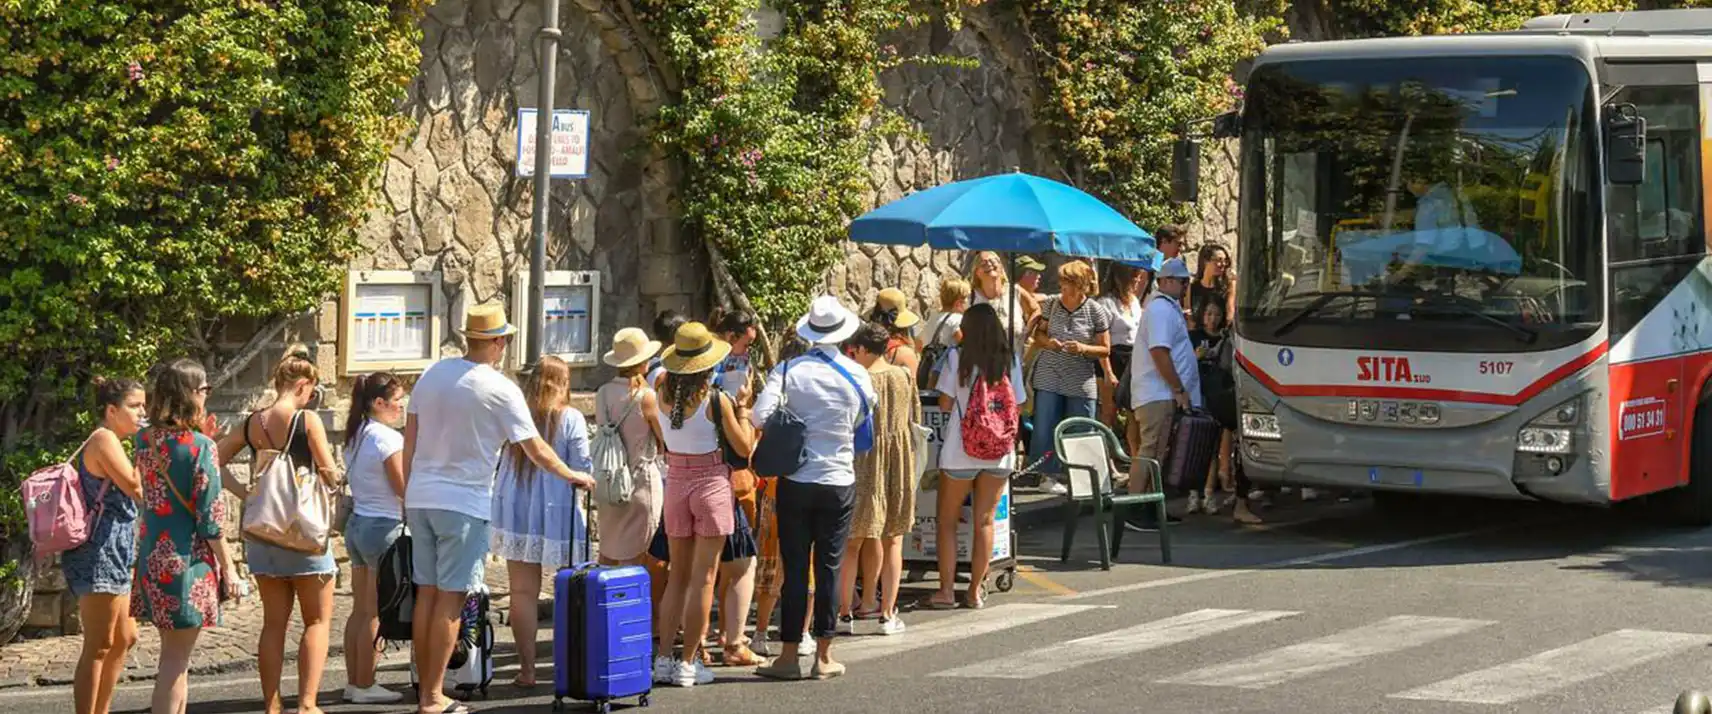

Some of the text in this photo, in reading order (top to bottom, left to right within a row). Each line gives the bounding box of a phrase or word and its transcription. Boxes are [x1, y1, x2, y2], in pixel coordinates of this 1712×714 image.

[1357, 356, 1431, 384] SITA SUD
[1479, 361, 1514, 375] 5107
[1348, 399, 1442, 424] IVECO
